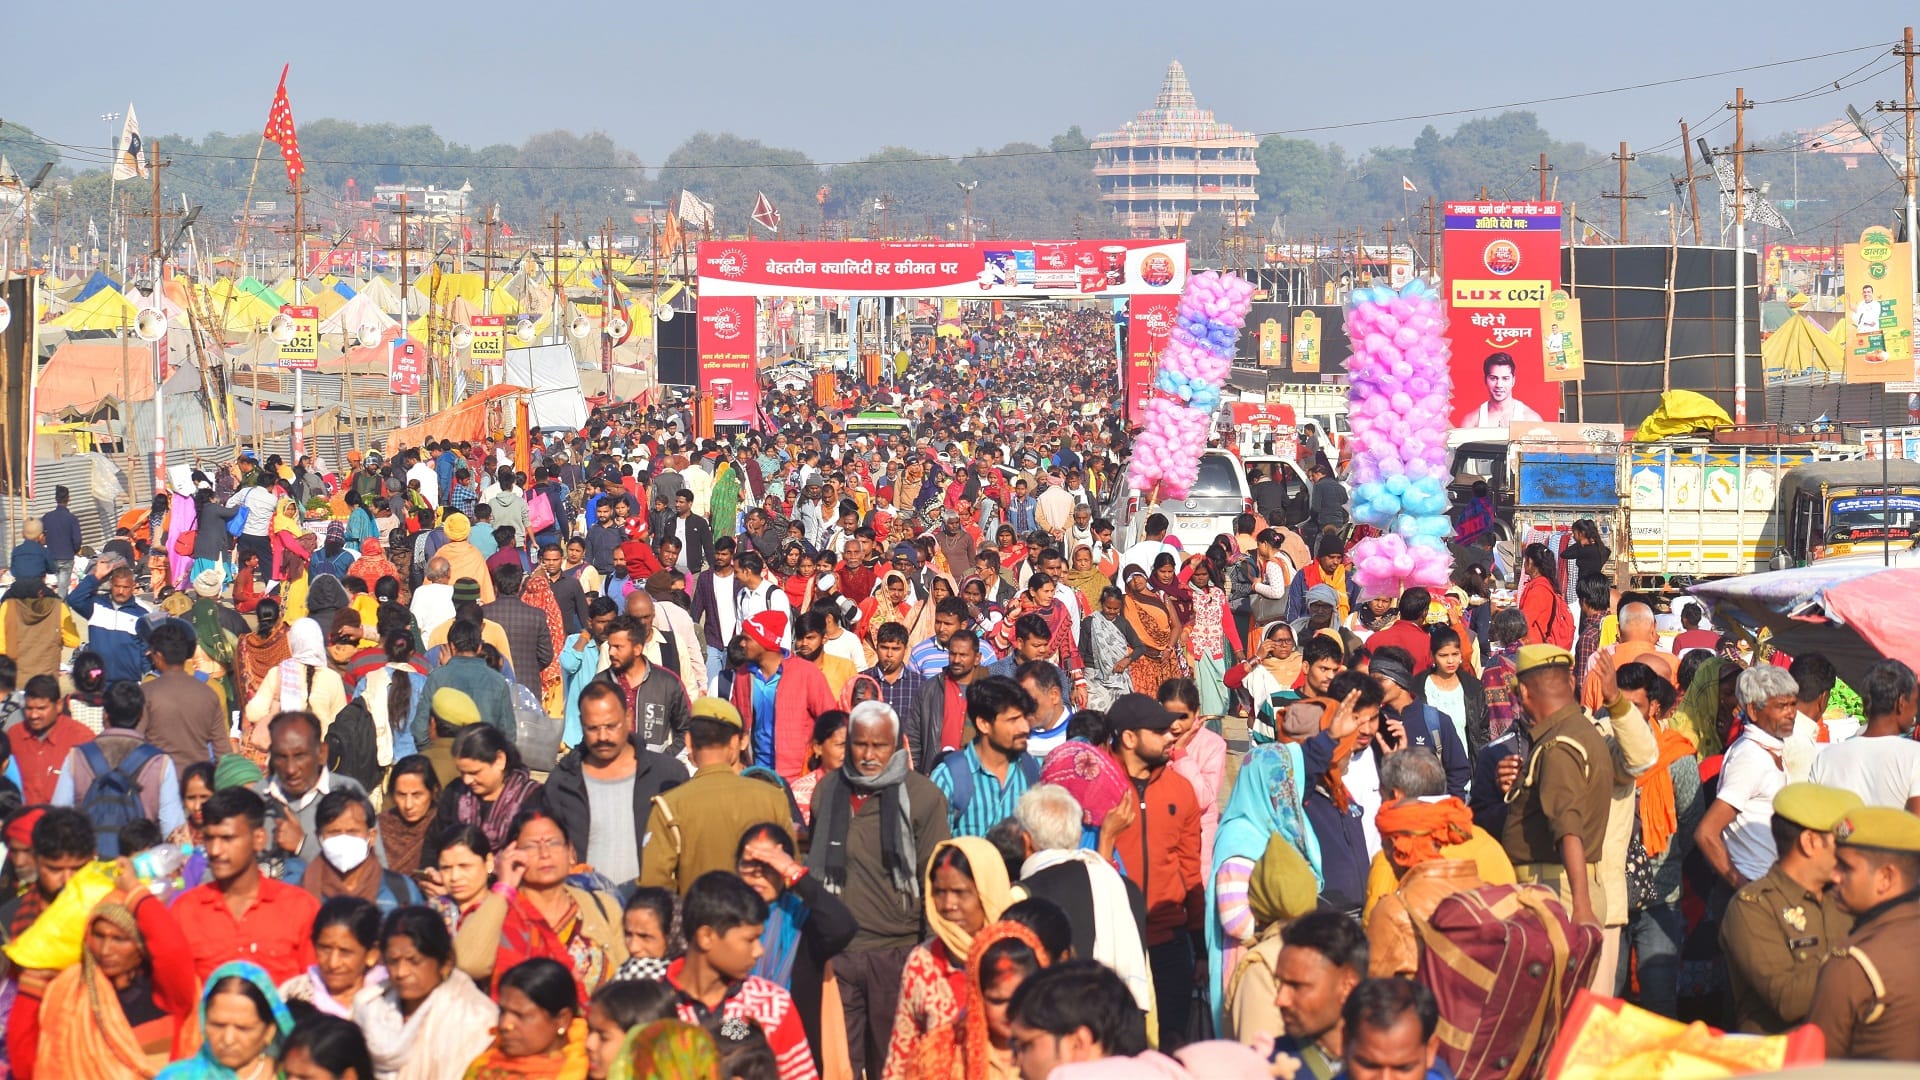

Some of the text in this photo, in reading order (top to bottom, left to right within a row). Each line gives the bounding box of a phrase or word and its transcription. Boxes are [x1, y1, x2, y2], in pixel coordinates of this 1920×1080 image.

[1525, 203, 1537, 214] मेला
[1863, 246, 1888, 256] डालडा
[765, 257, 959, 275] बेहतरीन क्वालिटी हर कीमत पर
[1456, 284, 1544, 301] LUX cozi
[1470, 313, 1506, 327] चेहरे पे
[1492, 328, 1533, 342] मुस्कान
[473, 338, 499, 350] cozi
